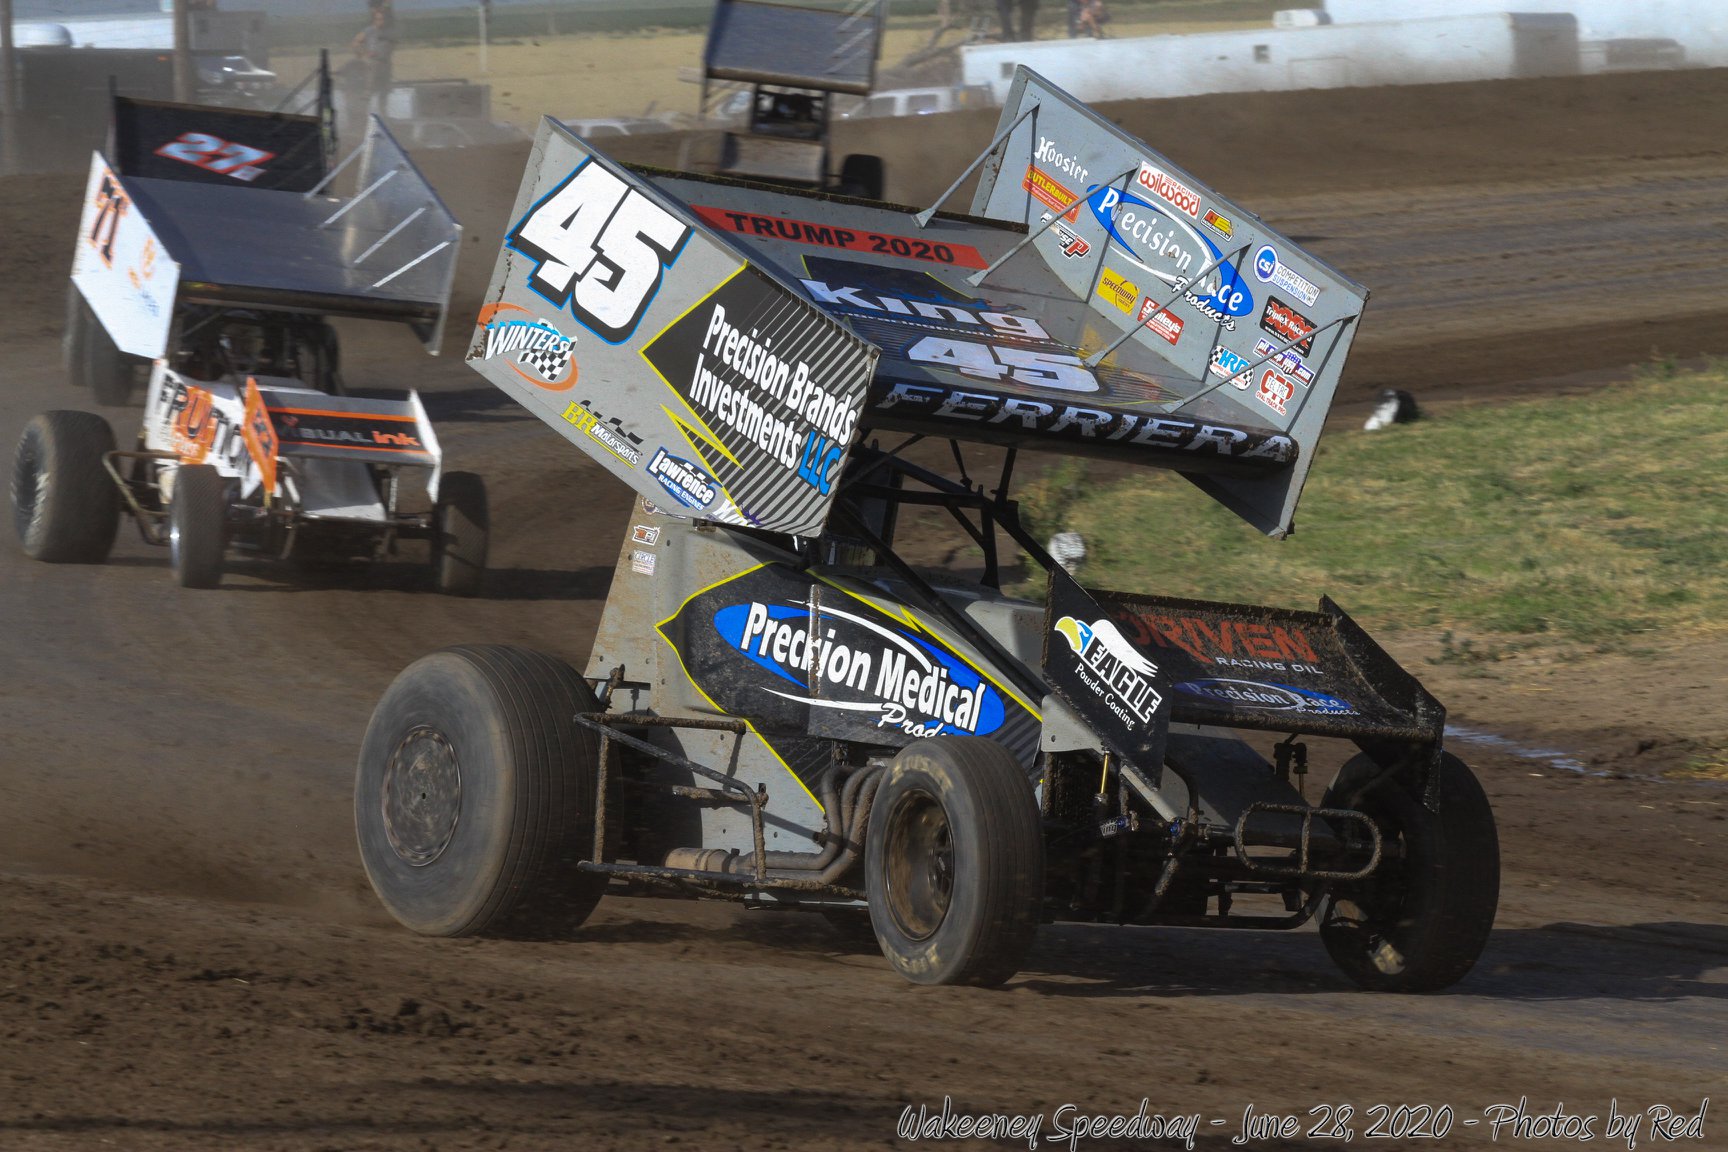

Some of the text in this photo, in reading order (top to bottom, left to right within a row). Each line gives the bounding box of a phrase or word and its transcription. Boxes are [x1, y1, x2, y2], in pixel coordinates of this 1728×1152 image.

[155, 132, 276, 174] 27
[1034, 136, 1088, 183] Hoosier
[1028, 170, 1073, 205] BUTLERBUILT
[1140, 169, 1200, 216] wilwood
[1171, 181, 1197, 201] RACING
[512, 158, 691, 338] 45
[725, 212, 955, 263] TRUMP 2020
[1102, 277, 1136, 303] SPEEDWAY
[1273, 275, 1308, 300] SUSPENSION
[1276, 265, 1319, 297] COMPETITION
[484, 322, 570, 361] WINTERS
[906, 336, 1100, 392] 45
[702, 303, 858, 446] Precision Brands
[591, 423, 640, 466] Motorsports
[689, 352, 841, 497] Investments LLC
[875, 384, 1295, 463] FERRIERA
[649, 451, 714, 504] Lawrence
[658, 474, 682, 495] RACING
[681, 491, 704, 511] ENGINES
[740, 601, 986, 733] Preciion Medical
[1081, 635, 1162, 724] EAGLE
[1215, 657, 1324, 674] RACING OIL
[1074, 662, 1136, 731] Powder Coating
[1185, 681, 1290, 706] Precision
[877, 702, 946, 738] Prod
